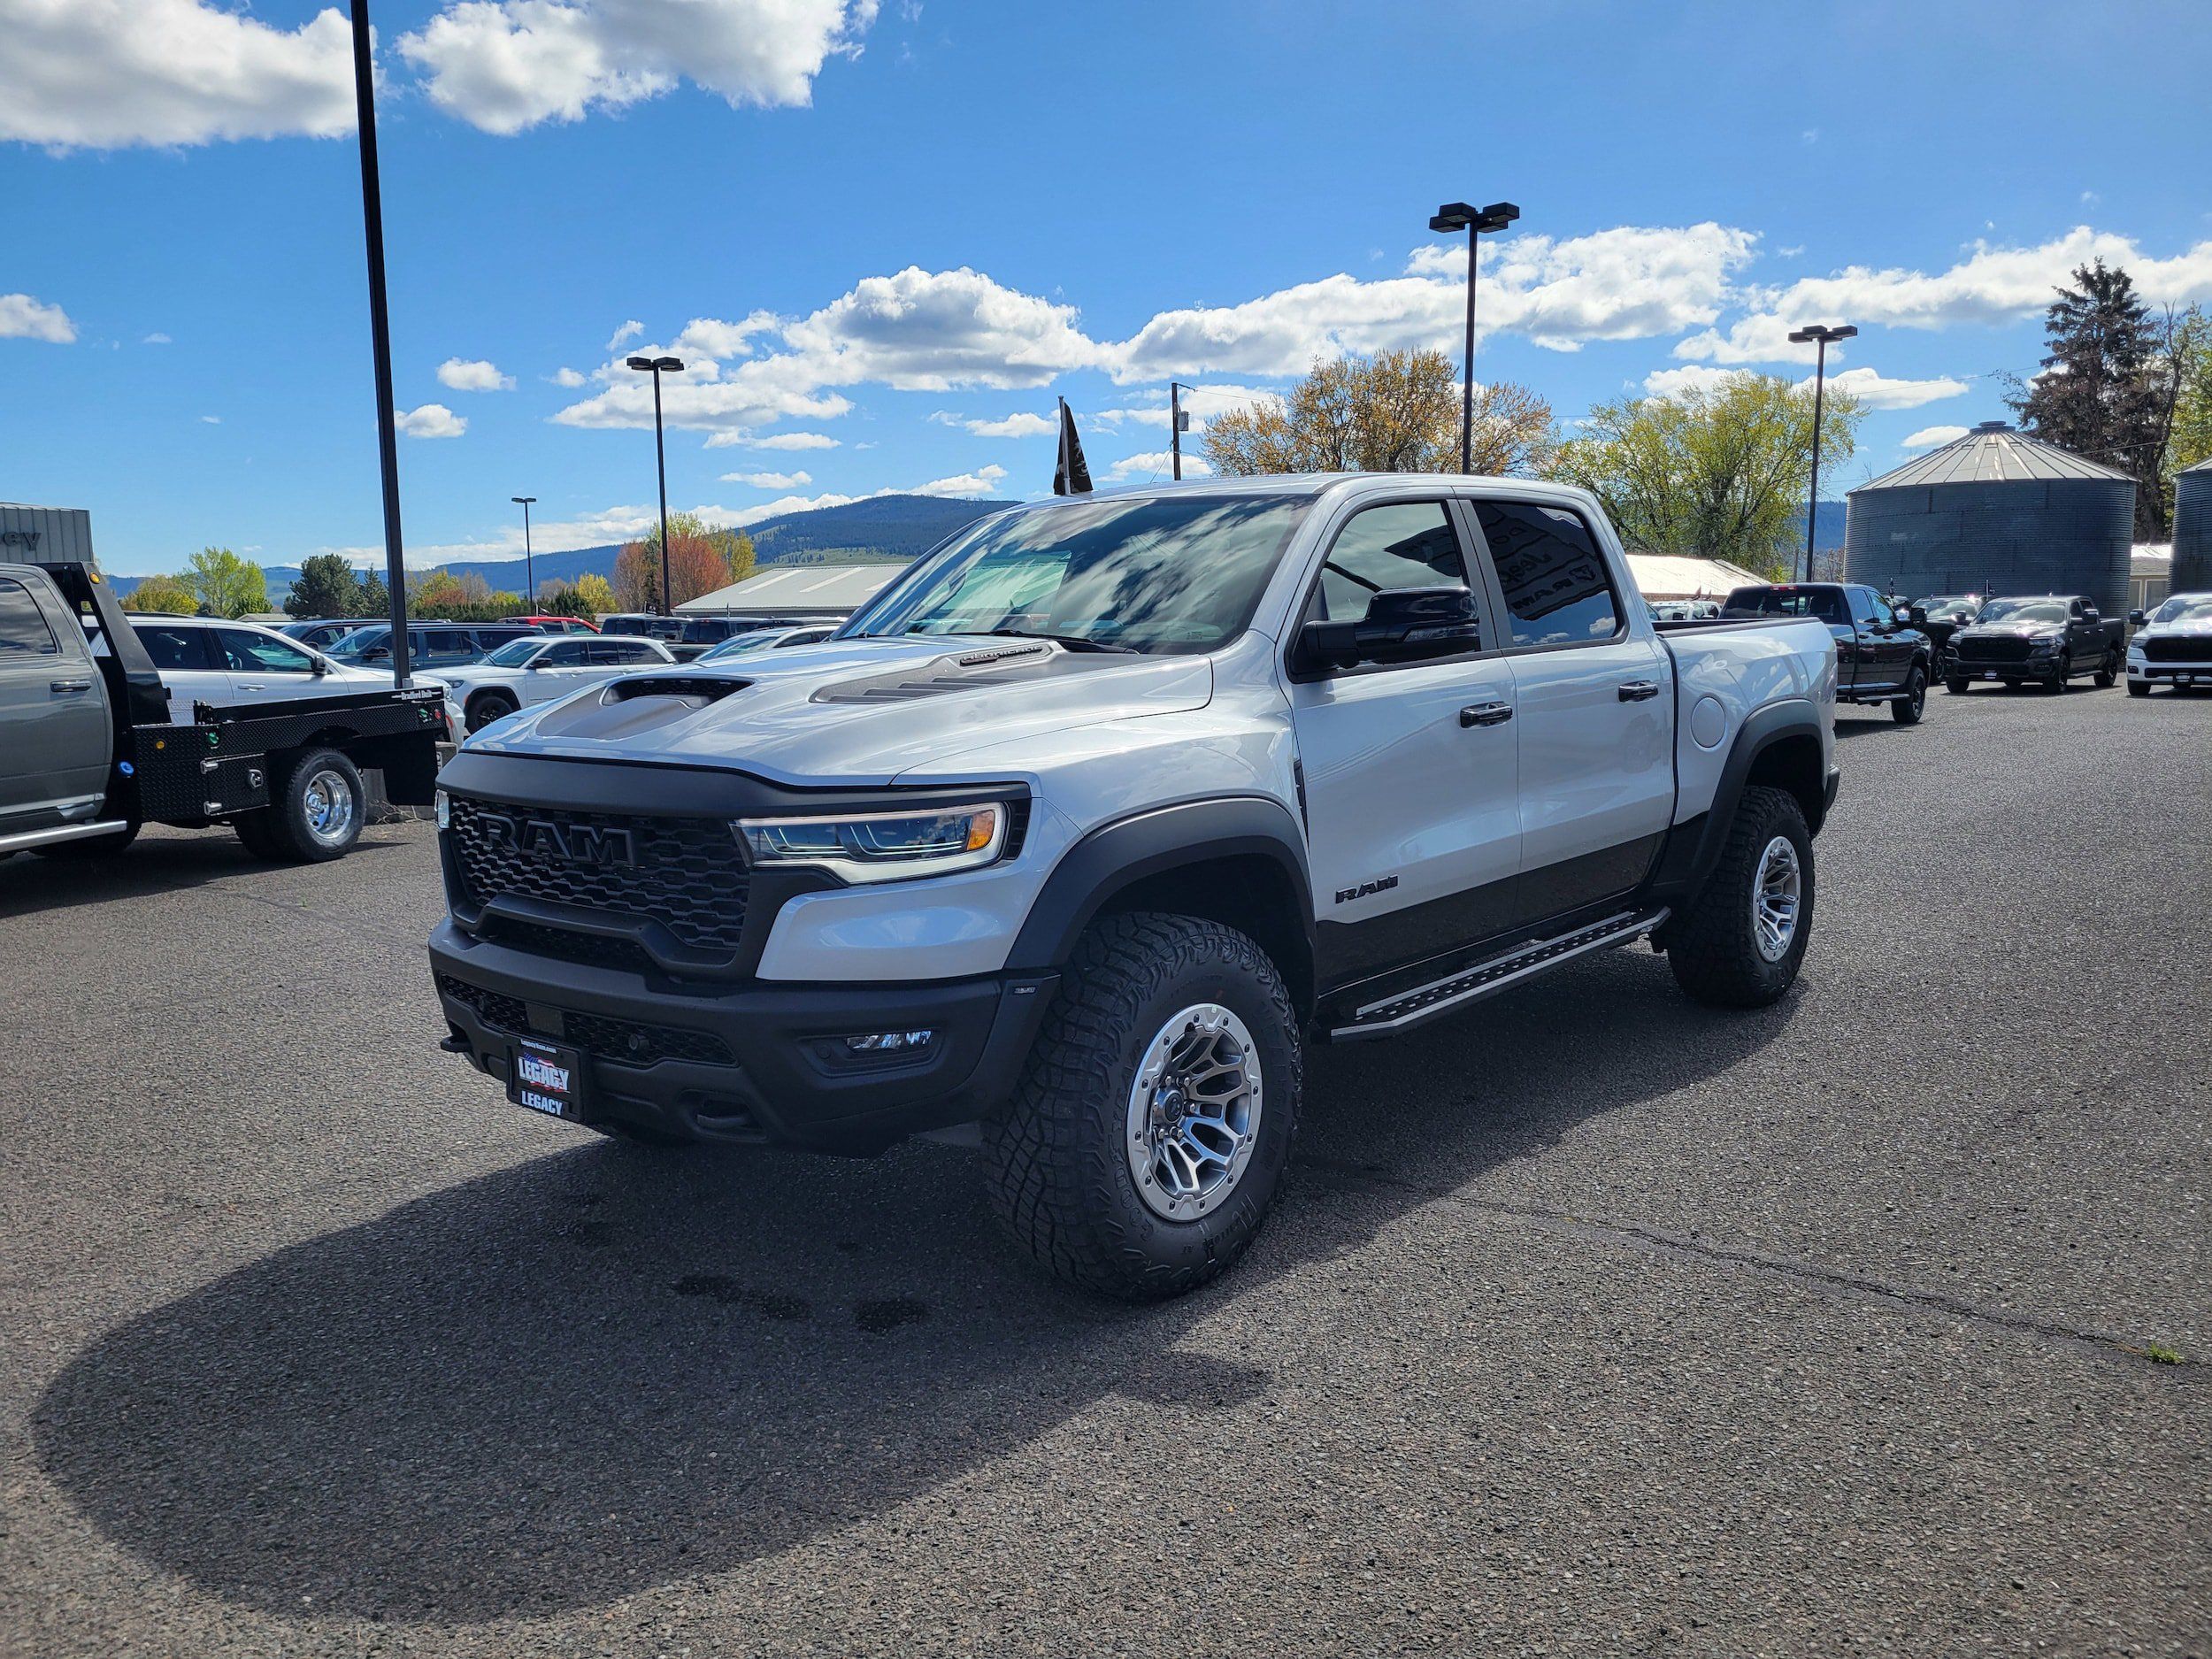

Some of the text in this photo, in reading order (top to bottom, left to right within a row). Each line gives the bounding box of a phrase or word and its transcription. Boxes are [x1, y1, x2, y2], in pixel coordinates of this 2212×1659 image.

[476, 811, 634, 866] RAM
[1335, 874, 1399, 903] RAM
[518, 1056, 570, 1091] LEGACY
[521, 1090, 564, 1116] LEGACY
